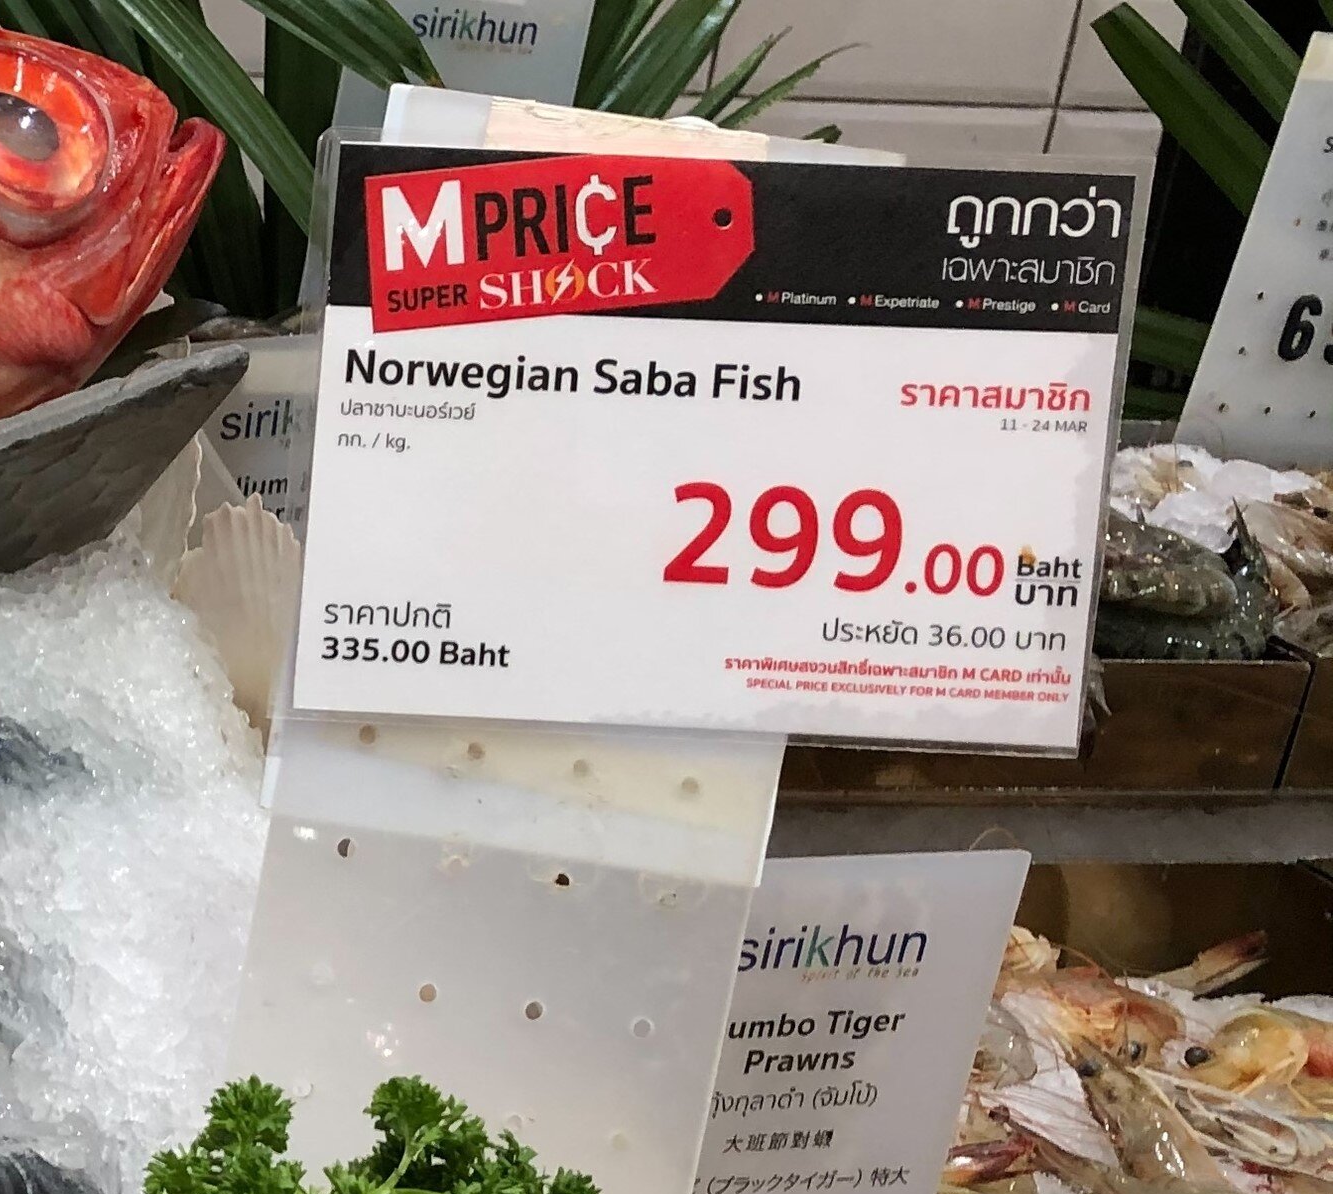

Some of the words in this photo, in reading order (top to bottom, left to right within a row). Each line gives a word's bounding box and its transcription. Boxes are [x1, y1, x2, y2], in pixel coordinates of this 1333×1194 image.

[412, 6, 538, 46] sirikhun
[946, 185, 1122, 249] ถูกกว่า
[387, 283, 468, 313] SUPER
[479, 257, 658, 310] SHOCK
[941, 255, 1116, 286] เฉพาะสมาชิก
[1078, 300, 1111, 314] Card
[1277, 293, 1333, 366] 6
[344, 348, 579, 398] Norwegian
[593, 358, 697, 397] Saba
[712, 363, 802, 402] Fish
[899, 381, 1092, 412] ราคาสมาชิก
[1000, 418, 1017, 431] 11
[1032, 419, 1049, 432] 24
[1054, 420, 1088, 433] MAR
[337, 432, 367, 448] กก.
[385, 432, 411, 453] kg.
[662, 481, 1005, 597] 299.00
[1016, 553, 1083, 580] Baht
[1014, 582, 1079, 608] บาท
[324, 601, 452, 629] ราคาปกติ
[822, 617, 919, 646] ประหยัด
[928, 623, 1006, 650] 36.00
[1015, 629, 1067, 652] บาท
[321, 636, 430, 664] 335.00
[439, 640, 510, 667] Baht
[746, 677, 791, 690] SPECIAL
[795, 680, 828, 692] PRICE
[831, 682, 905, 696] EXCLUSIVELY
[910, 686, 933, 697] FOR
[935, 688, 946, 697] M
[949, 688, 981, 699] CARD
[984, 690, 1034, 702] MEMBER
[1037, 692, 1070, 702] ONLY
[962, 667, 976, 680] M
[980, 668, 1023, 683] CARD
[738, 924, 927, 972] sirikhun
[727, 1013, 815, 1040] umbo
[827, 1010, 906, 1039] Tiger
[742, 1049, 856, 1075] Prawns
